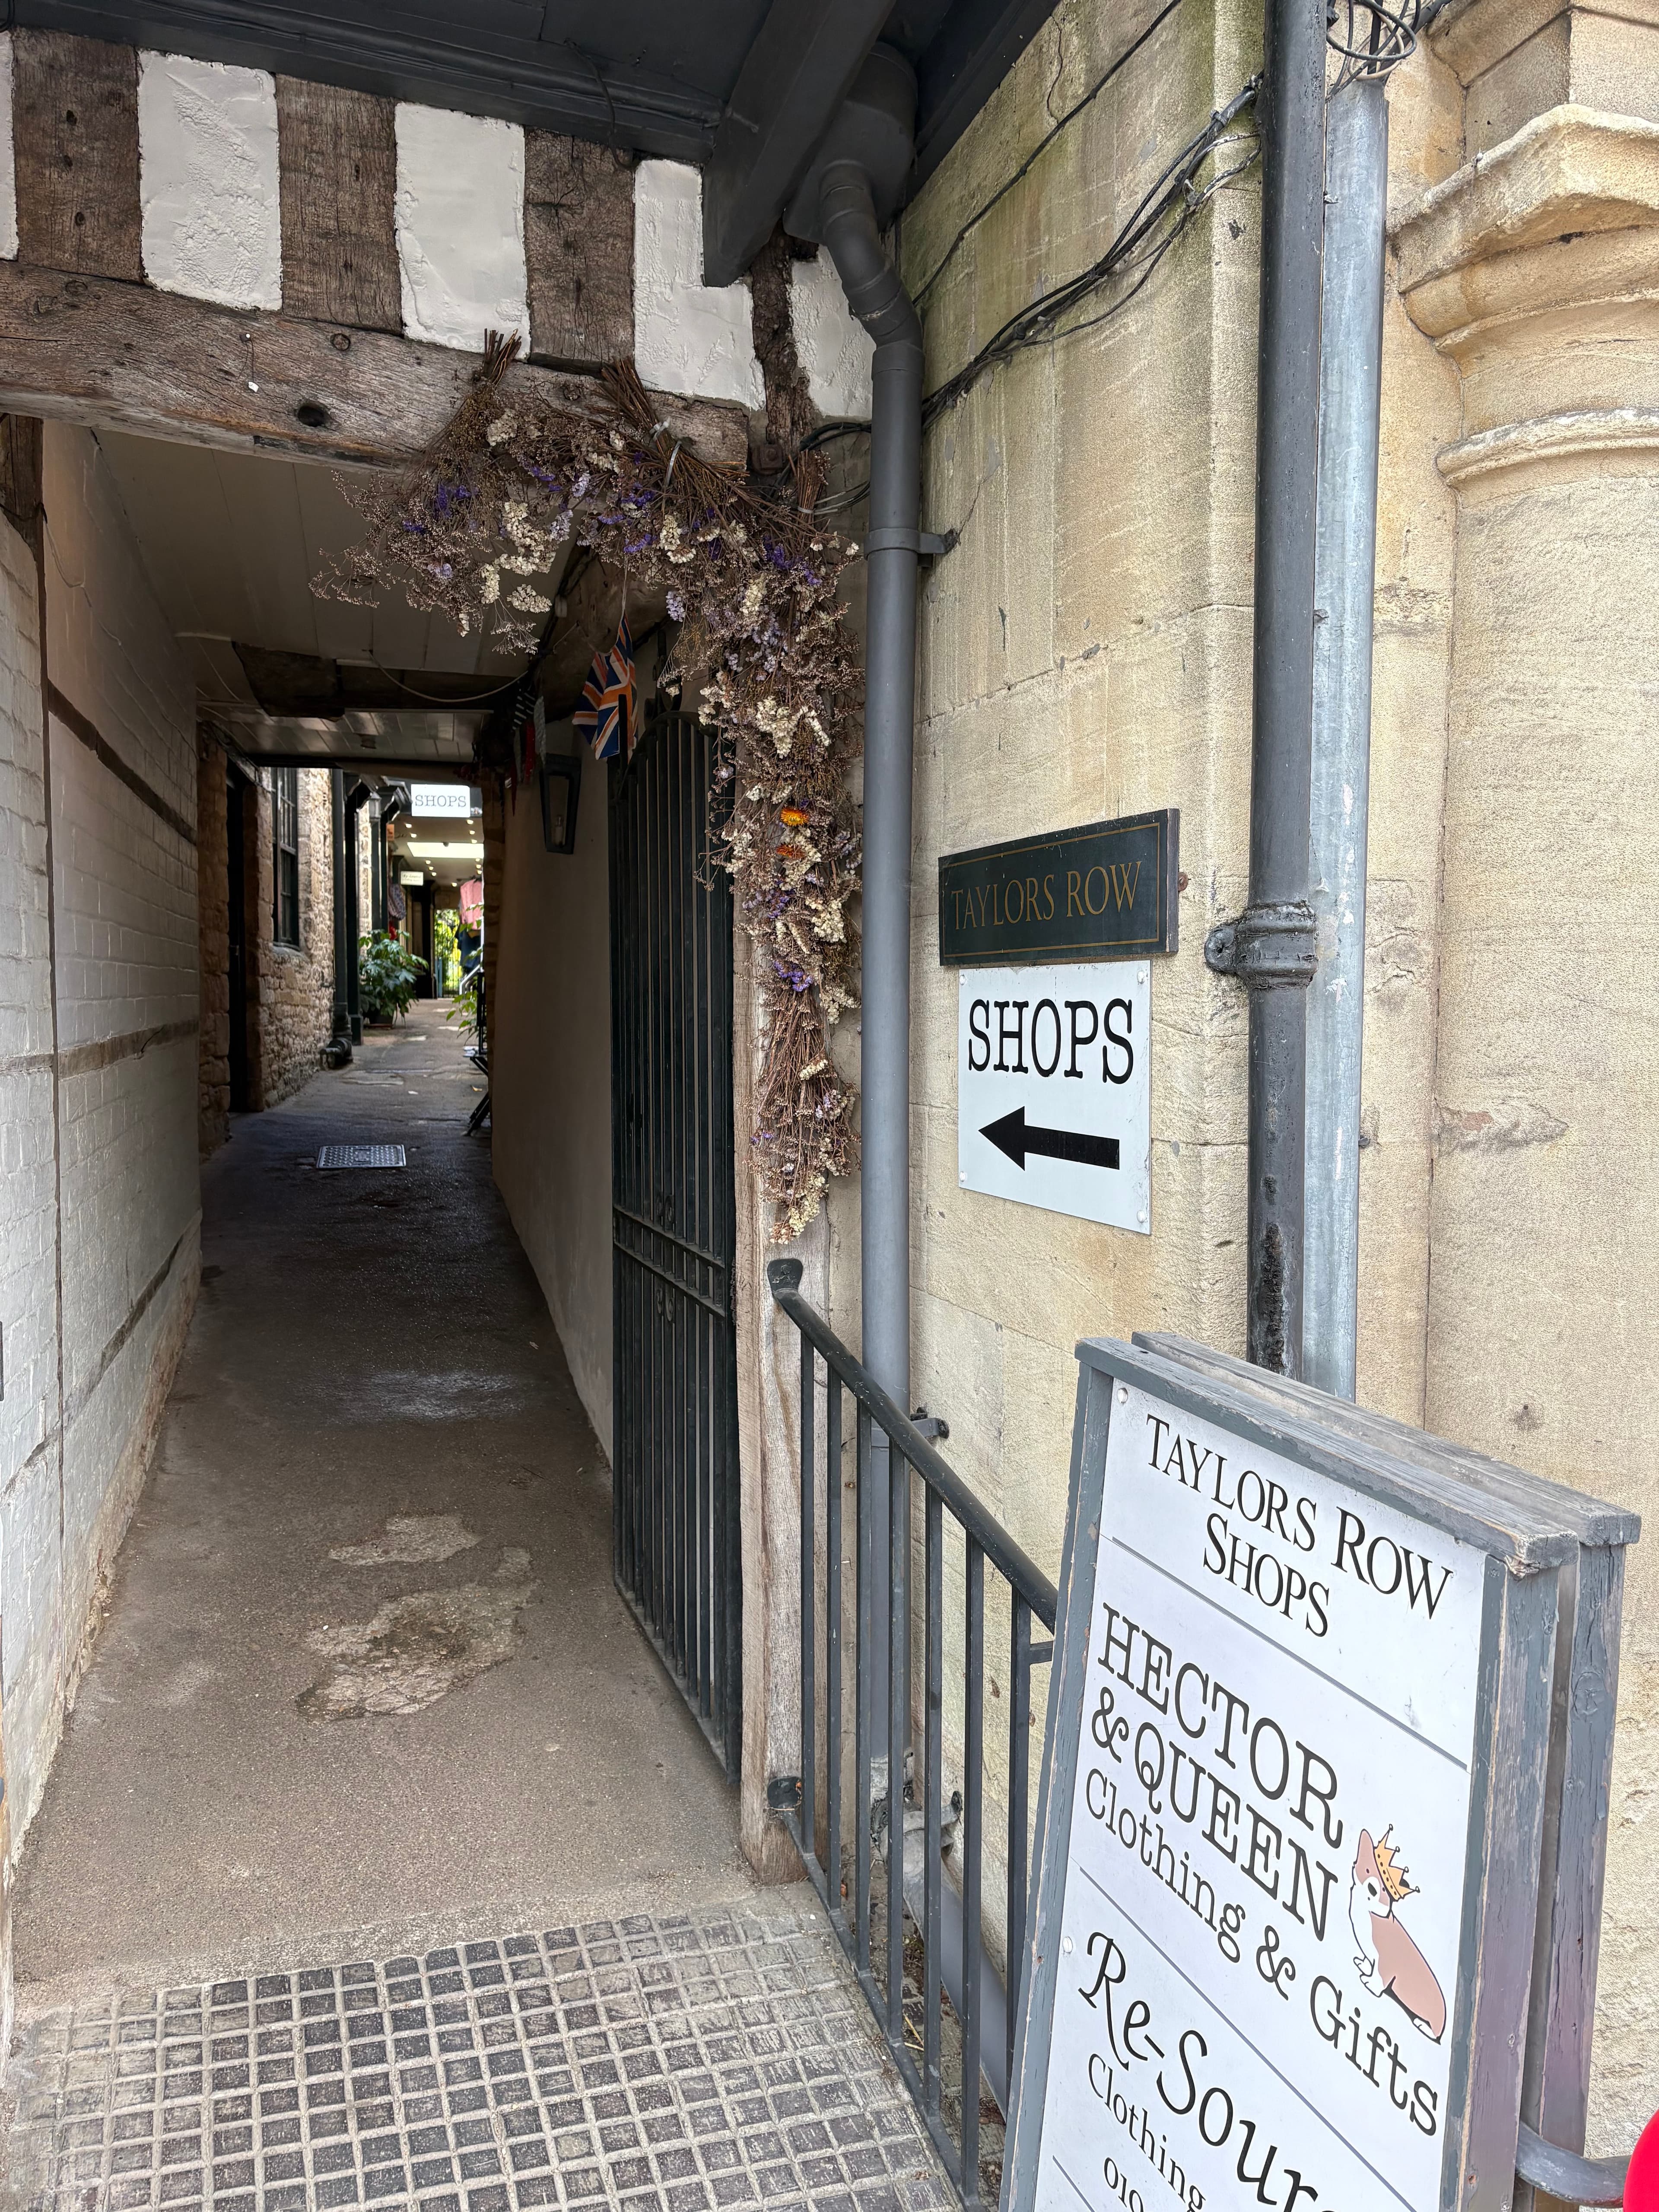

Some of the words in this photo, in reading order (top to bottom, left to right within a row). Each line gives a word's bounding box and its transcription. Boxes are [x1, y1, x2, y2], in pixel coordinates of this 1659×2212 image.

[415, 795, 467, 807] SHOPS
[951, 874, 1055, 930] TAYLORS
[1066, 861, 1142, 917] ROW
[969, 998, 1134, 1084] SHOPS
[1146, 1414, 1316, 1551] TAYLORS
[1331, 1506, 1454, 1619] ROW
[1203, 1513, 1329, 1637] SHOPS
[1098, 1602, 1343, 1849] HECTOR
[1086, 1768, 1246, 1963] Clothing
[1256, 1925, 1296, 2001] &
[1310, 1976, 1438, 2136] Gifts
[1078, 1932, 1335, 2212] Re-Sour
